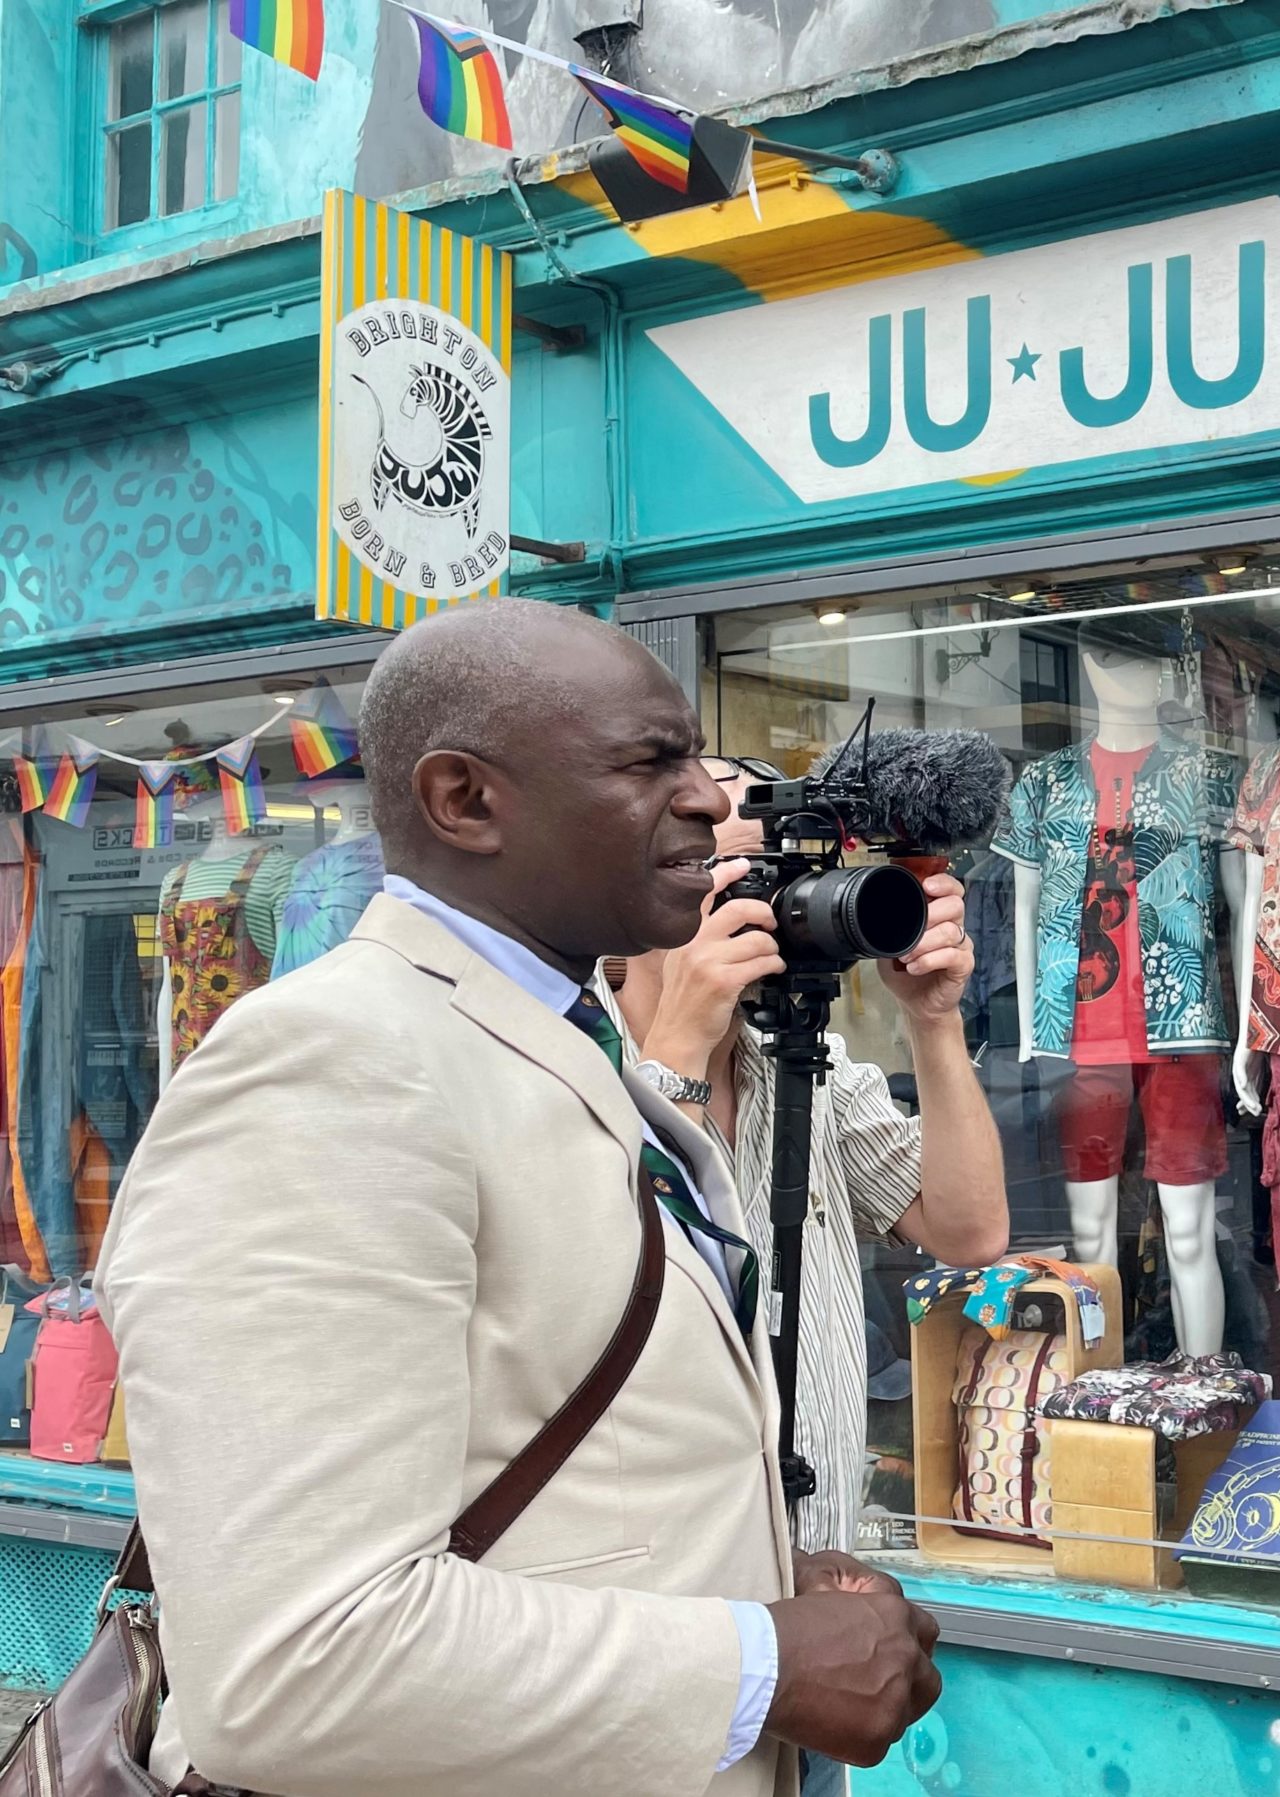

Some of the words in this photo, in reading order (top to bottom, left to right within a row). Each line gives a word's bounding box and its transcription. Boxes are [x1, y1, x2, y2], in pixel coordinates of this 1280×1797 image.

[346, 311, 497, 395] BRIGHTON
[808, 295, 991, 468] JU
[1059, 239, 1265, 428] JU
[339, 498, 407, 578] BORN
[420, 563, 437, 588] &
[448, 530, 507, 587] BRED
